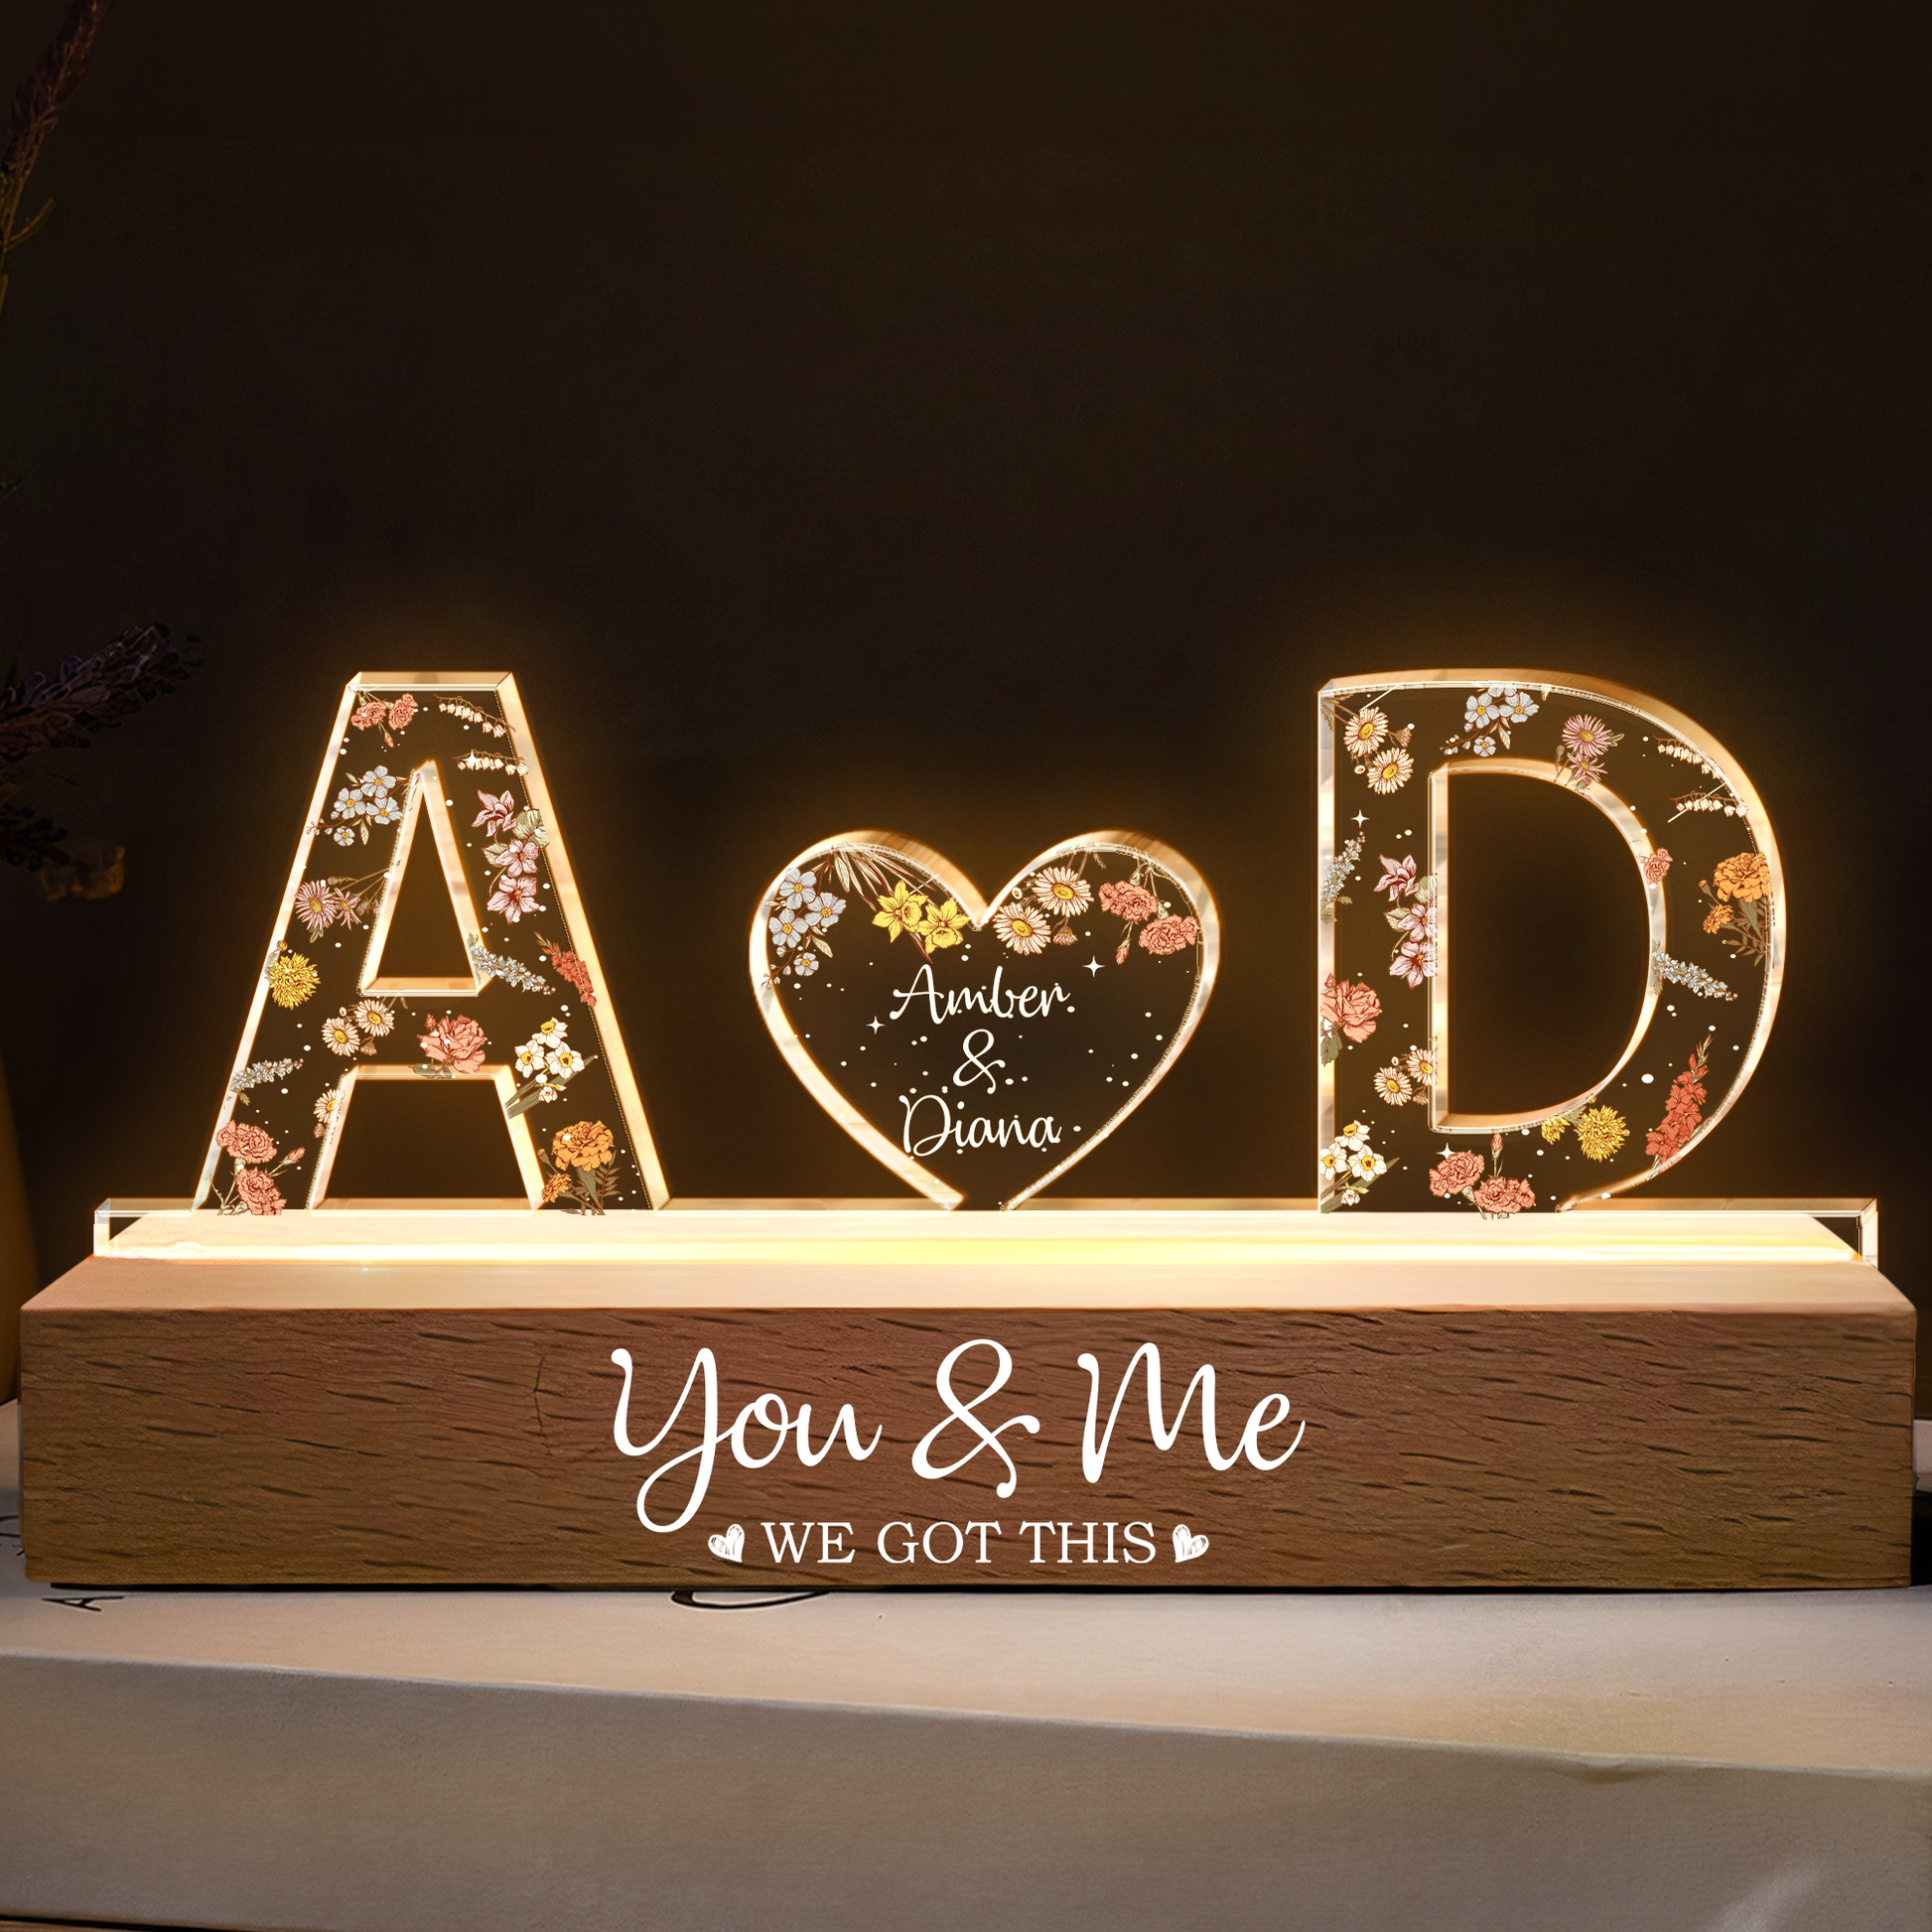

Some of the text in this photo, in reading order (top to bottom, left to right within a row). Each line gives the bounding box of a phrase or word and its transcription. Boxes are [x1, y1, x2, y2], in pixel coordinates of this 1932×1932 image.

[193, 668, 1786, 1213] A D
[890, 964, 1070, 1024] Amber
[953, 1029, 1006, 1094] &
[899, 1094, 1061, 1157] Diana
[612, 1338, 1306, 1533] You & Me
[761, 1521, 1157, 1564] WE GOT THIS
